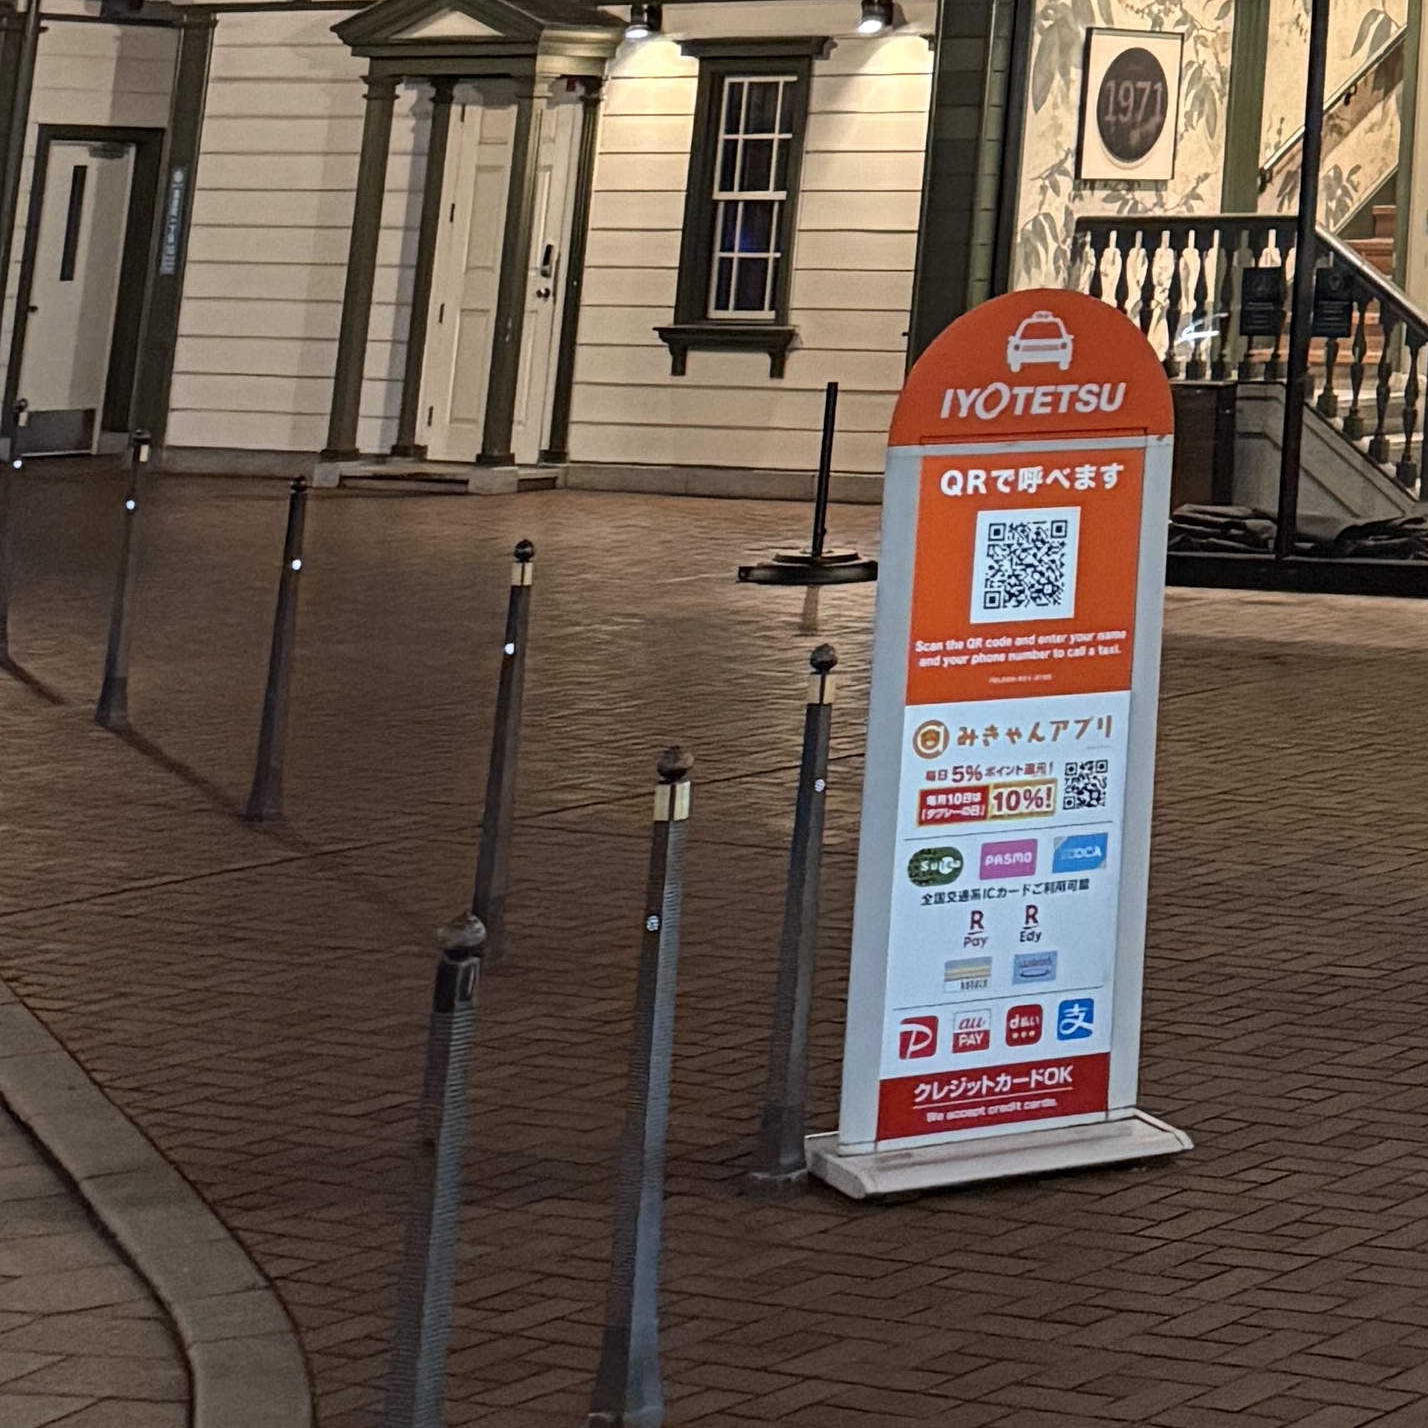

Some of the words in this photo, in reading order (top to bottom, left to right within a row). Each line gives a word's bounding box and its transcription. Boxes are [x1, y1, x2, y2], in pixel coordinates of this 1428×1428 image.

[1104, 80, 1163, 122] 1971
[940, 382, 1127, 420] IYOTETSU
[940, 462, 1125, 497] QRで呼べます
[915, 640, 943, 652] Scan
[946, 639, 964, 650] the
[966, 638, 983, 649] QR
[985, 636, 1012, 648] code
[1014, 634, 1035, 646] and
[1037, 633, 1066, 645] enter
[1069, 632, 1094, 644] your
[919, 655, 940, 667] and
[942, 654, 967, 668] your
[971, 652, 1005, 666] phone
[1008, 649, 1051, 662] number
[1053, 647, 1065, 659] to
[1067, 646, 1086, 658] call
[956, 715, 1112, 747] みきゃんアプリ
[993, 787, 1052, 812] 10%!
[985, 852, 1033, 866] PASMO
[970, 910, 985, 930] R
[1025, 904, 1039, 925] R
[963, 936, 989, 948] Pay
[1019, 931, 1042, 943] Edy
[958, 1016, 986, 1030] au
[1060, 1003, 1093, 1035] 支
[958, 1032, 984, 1047] PAY
[913, 1065, 1074, 1103] クレジットカードOK
[926, 1111, 944, 1123] We
